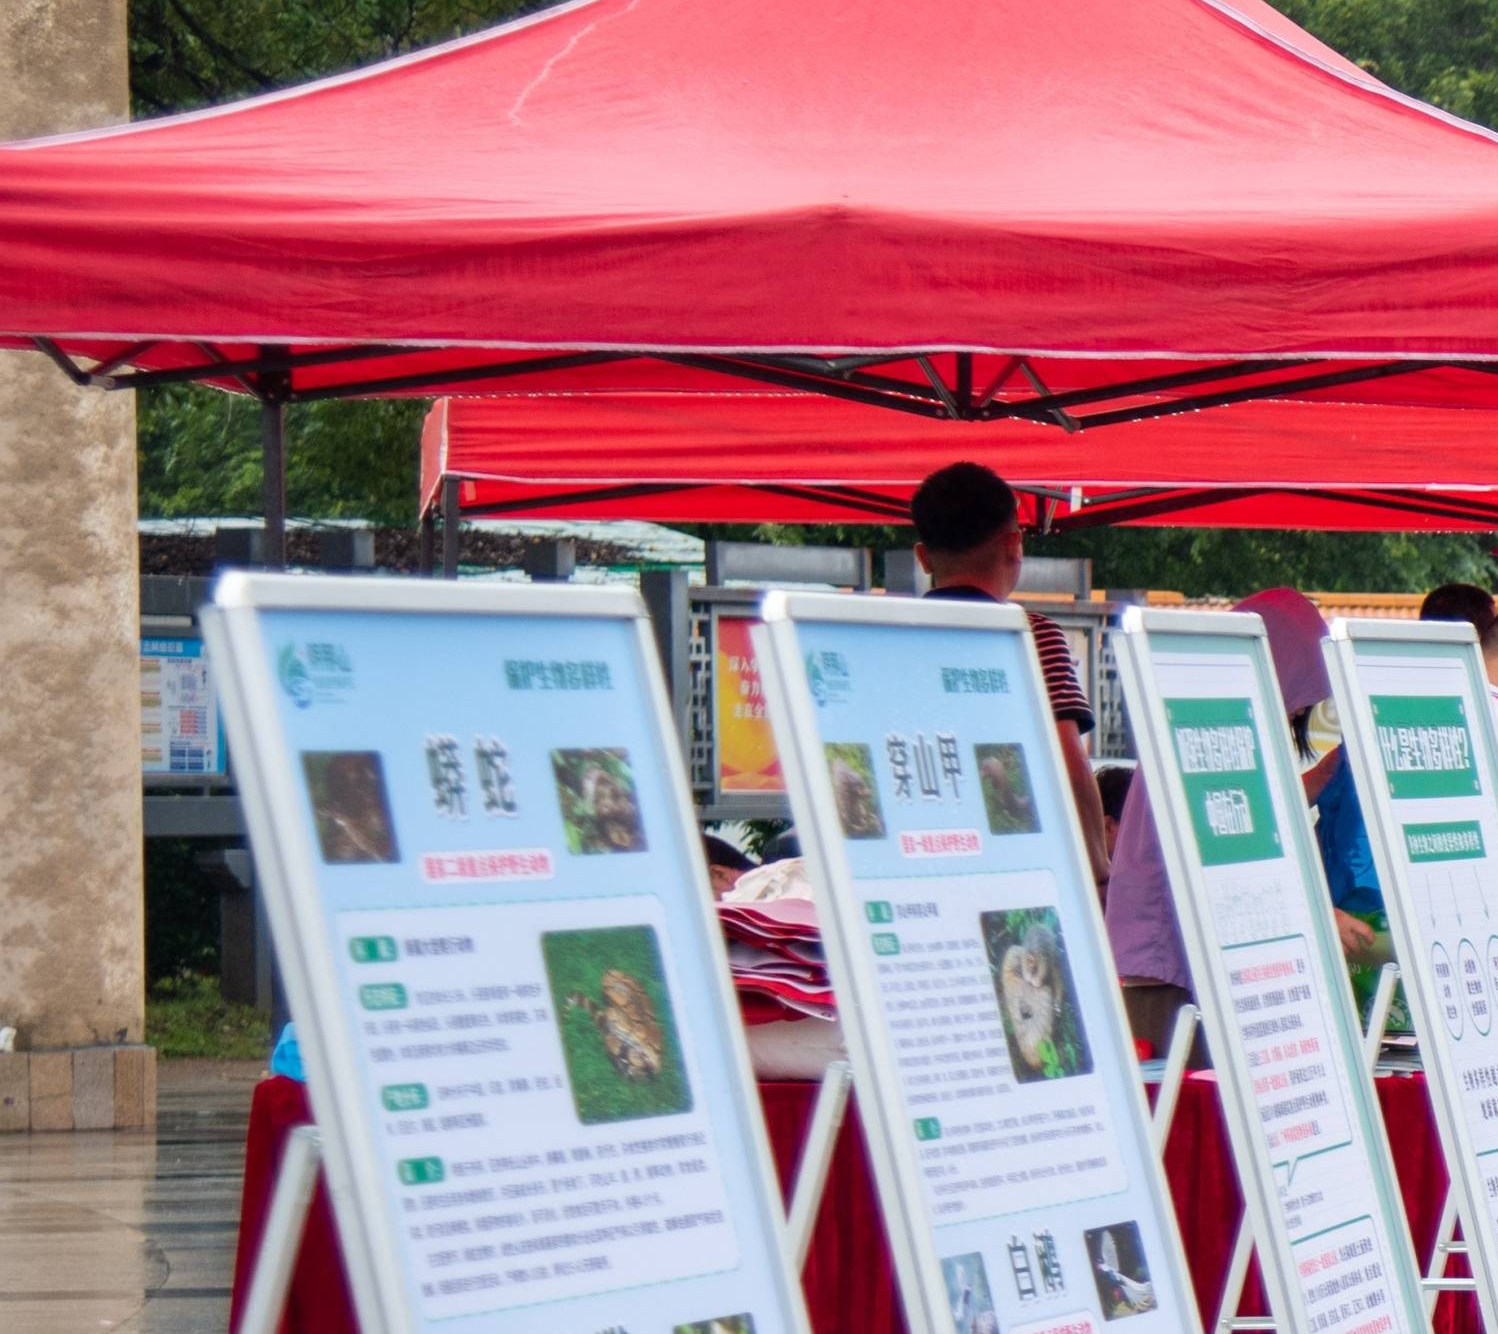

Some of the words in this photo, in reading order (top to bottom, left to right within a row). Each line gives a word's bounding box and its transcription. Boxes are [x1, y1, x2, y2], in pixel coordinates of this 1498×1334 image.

[424, 734, 517, 817] 蟒蛇
[885, 731, 961, 801] 穿山甲
